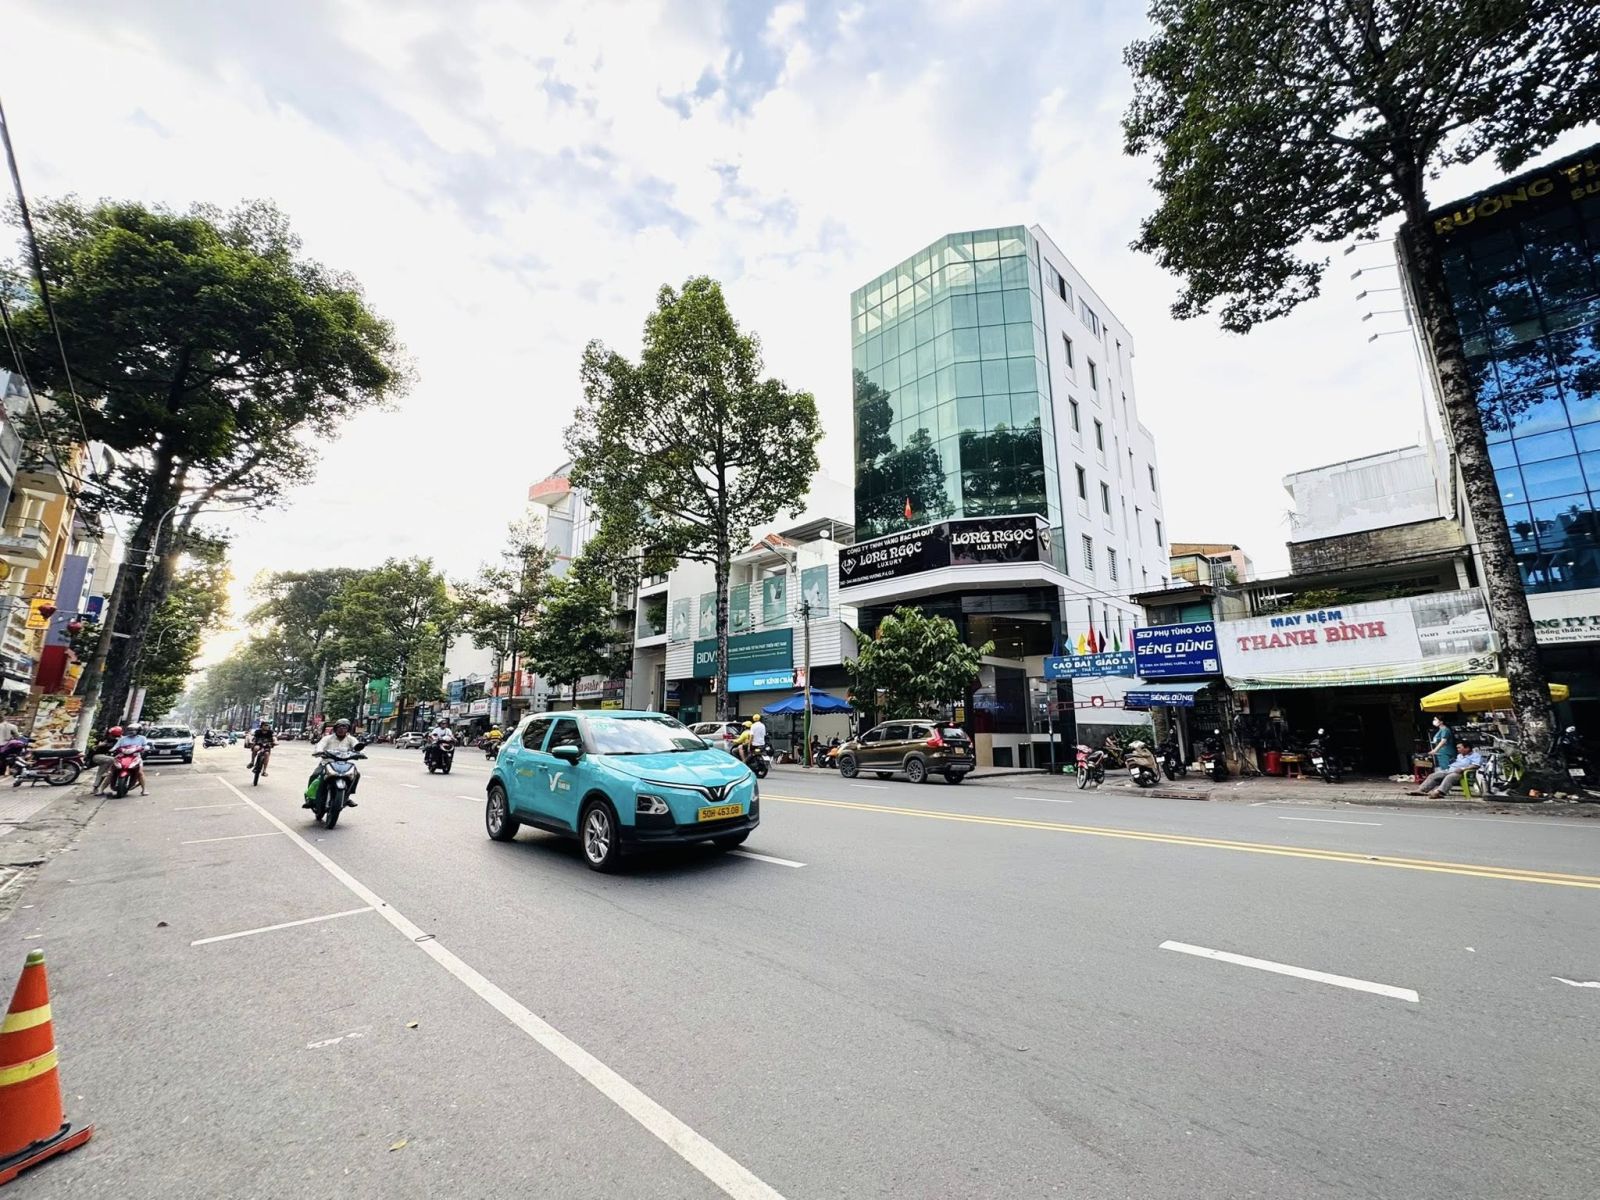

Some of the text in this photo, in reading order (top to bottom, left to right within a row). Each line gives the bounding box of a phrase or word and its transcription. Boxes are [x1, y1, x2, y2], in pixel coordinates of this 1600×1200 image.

[952, 528, 1034, 545] LONG NGỌC
[860, 542, 922, 566] LONG NGỌC
[877, 558, 903, 568] LUXURY
[1270, 610, 1342, 628] MAY NỆM
[1562, 616, 1586, 627] TY
[1171, 627, 1193, 635] TÙNG
[1237, 621, 1386, 651] THANH BÌNH
[1138, 639, 1214, 655] SÉNG DŨNG
[697, 652, 715, 664] BIDV
